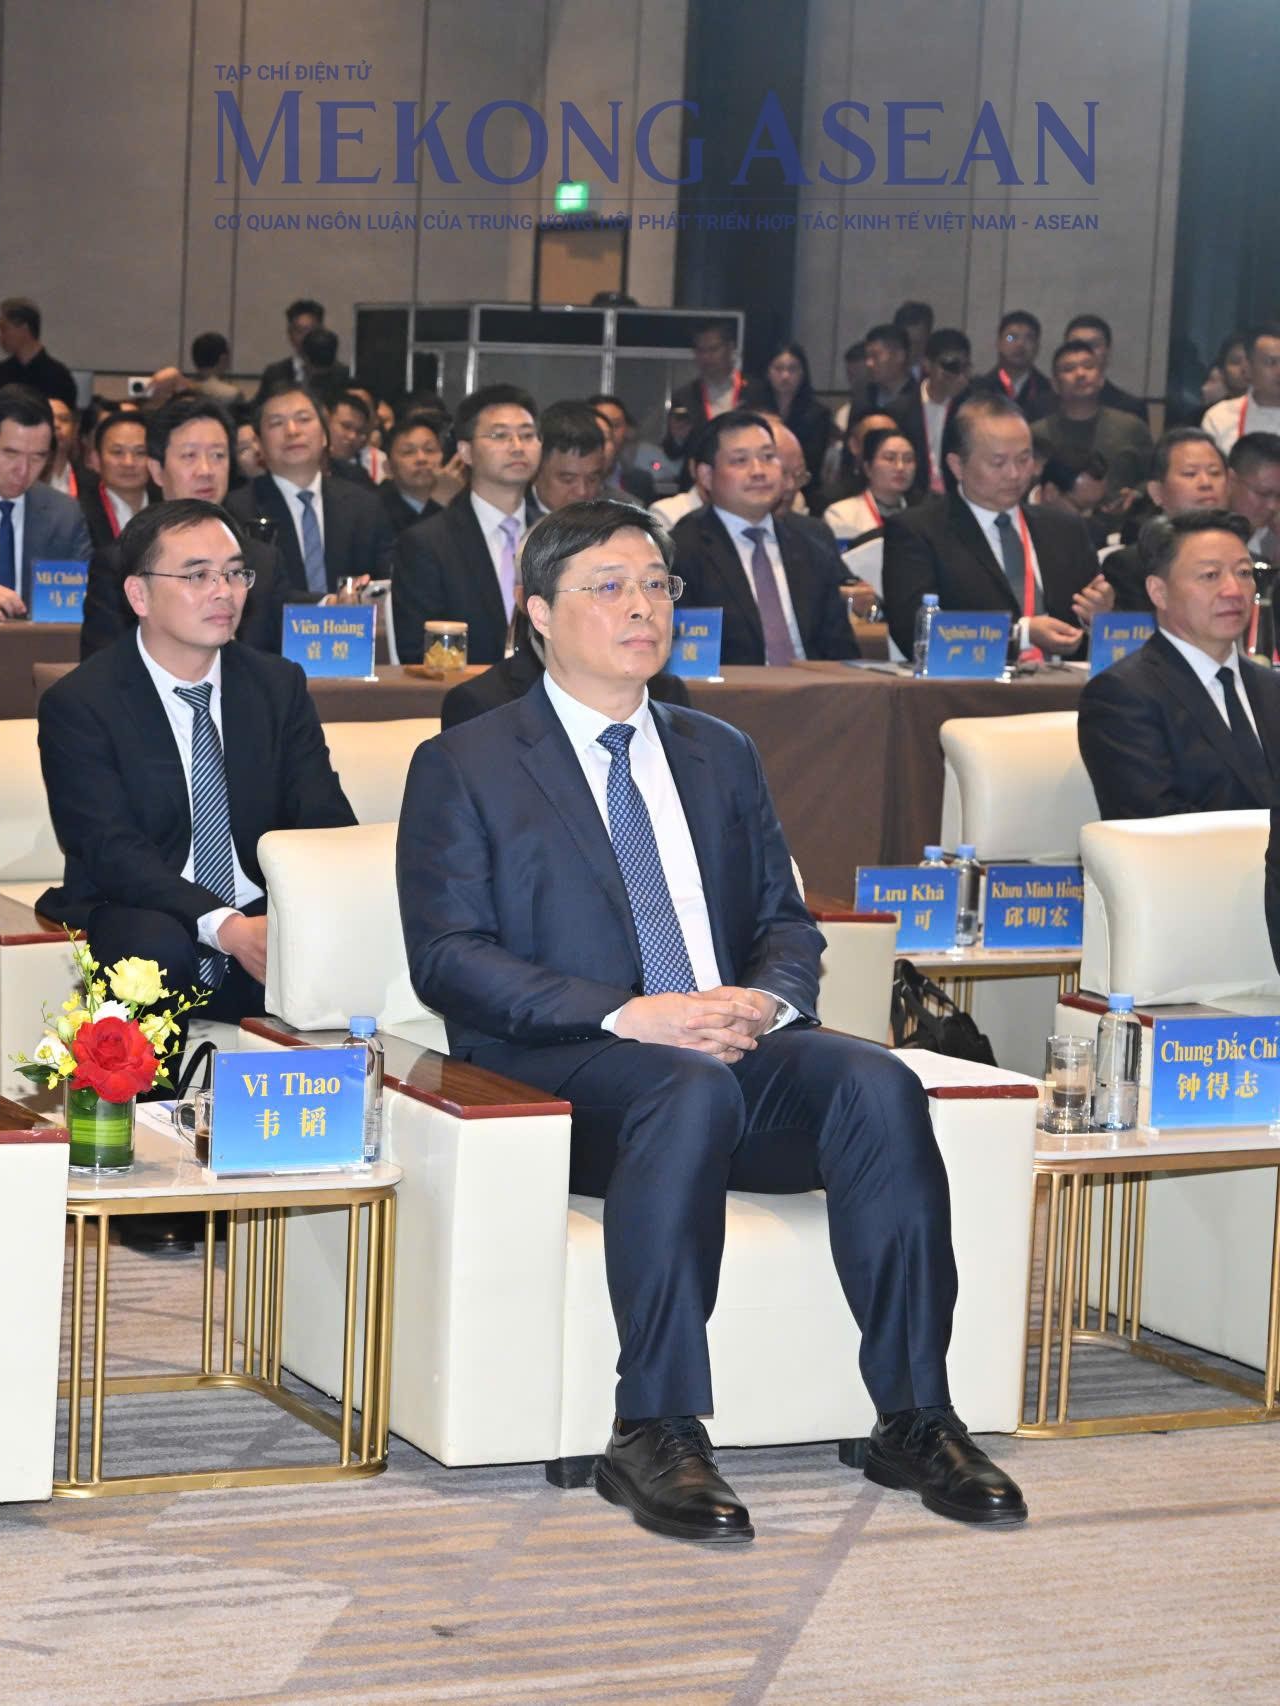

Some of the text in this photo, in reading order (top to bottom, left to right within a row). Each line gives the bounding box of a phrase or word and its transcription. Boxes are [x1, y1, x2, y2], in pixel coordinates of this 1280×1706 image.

[1160, 1031, 1279, 1067] Chung Đắc Chí
[241, 1072, 341, 1097] Vi Thao
[1177, 1069, 1260, 1101] 钟得志
[254, 1105, 327, 1140] 韦韬
